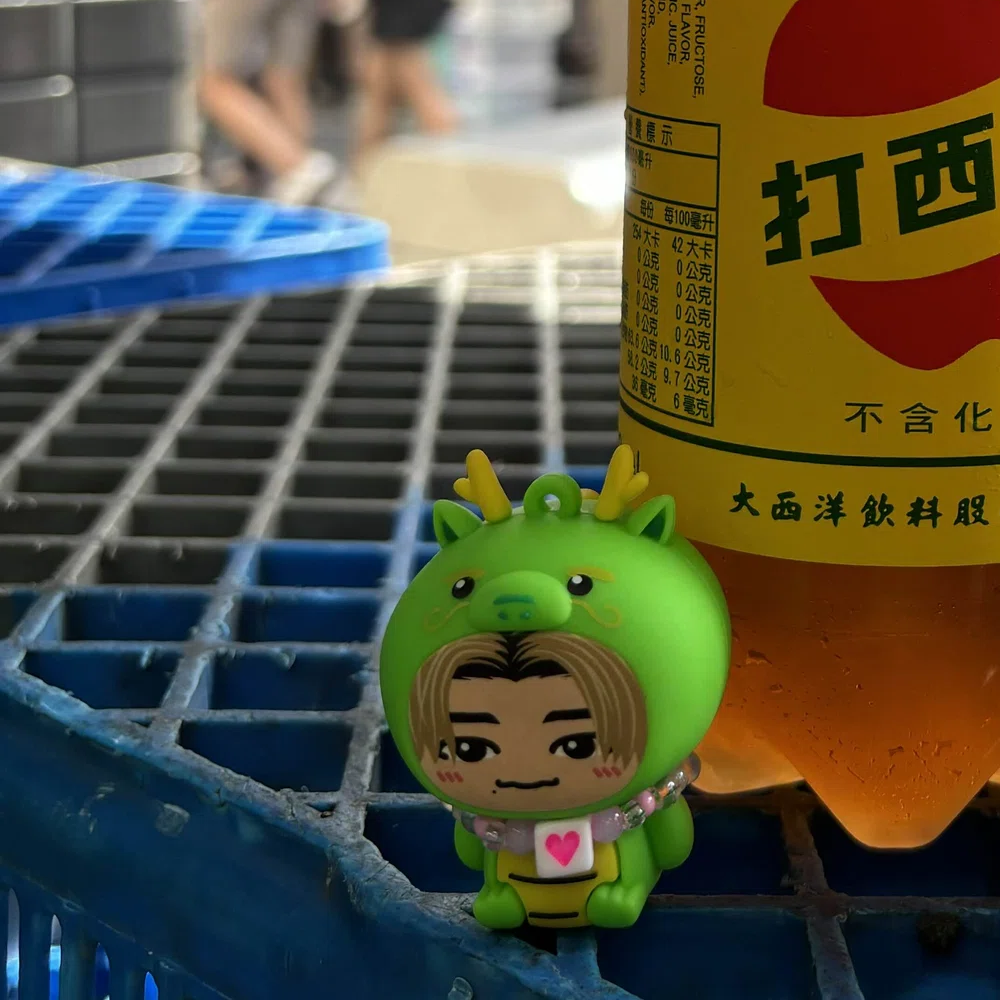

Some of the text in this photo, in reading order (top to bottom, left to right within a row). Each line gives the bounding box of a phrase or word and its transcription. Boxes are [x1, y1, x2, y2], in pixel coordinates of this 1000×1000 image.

[667, 21, 677, 65] JUICE,
[680, 4, 691, 64] FLAVOR,
[692, 16, 705, 98] FRUCTOSE,
[664, 206, 714, 232] 每100毫升
[672, 236, 683, 253] 42
[686, 239, 713, 259] 大卡
[677, 259, 682, 276] 0
[686, 261, 712, 283] 公克
[676, 281, 682, 298] 0
[685, 283, 712, 306] 公克
[676, 304, 681, 320] 0
[685, 305, 711, 328] 公克
[675, 326, 681, 342] 0
[684, 328, 710, 351] 公克
[660, 344, 680, 365] 10.6
[684, 350, 710, 374] 公克
[663, 367, 680, 387] 9.7
[683, 373, 709, 396] 公克
[673, 393, 680, 409] 6
[683, 394, 709, 419] 毫克
